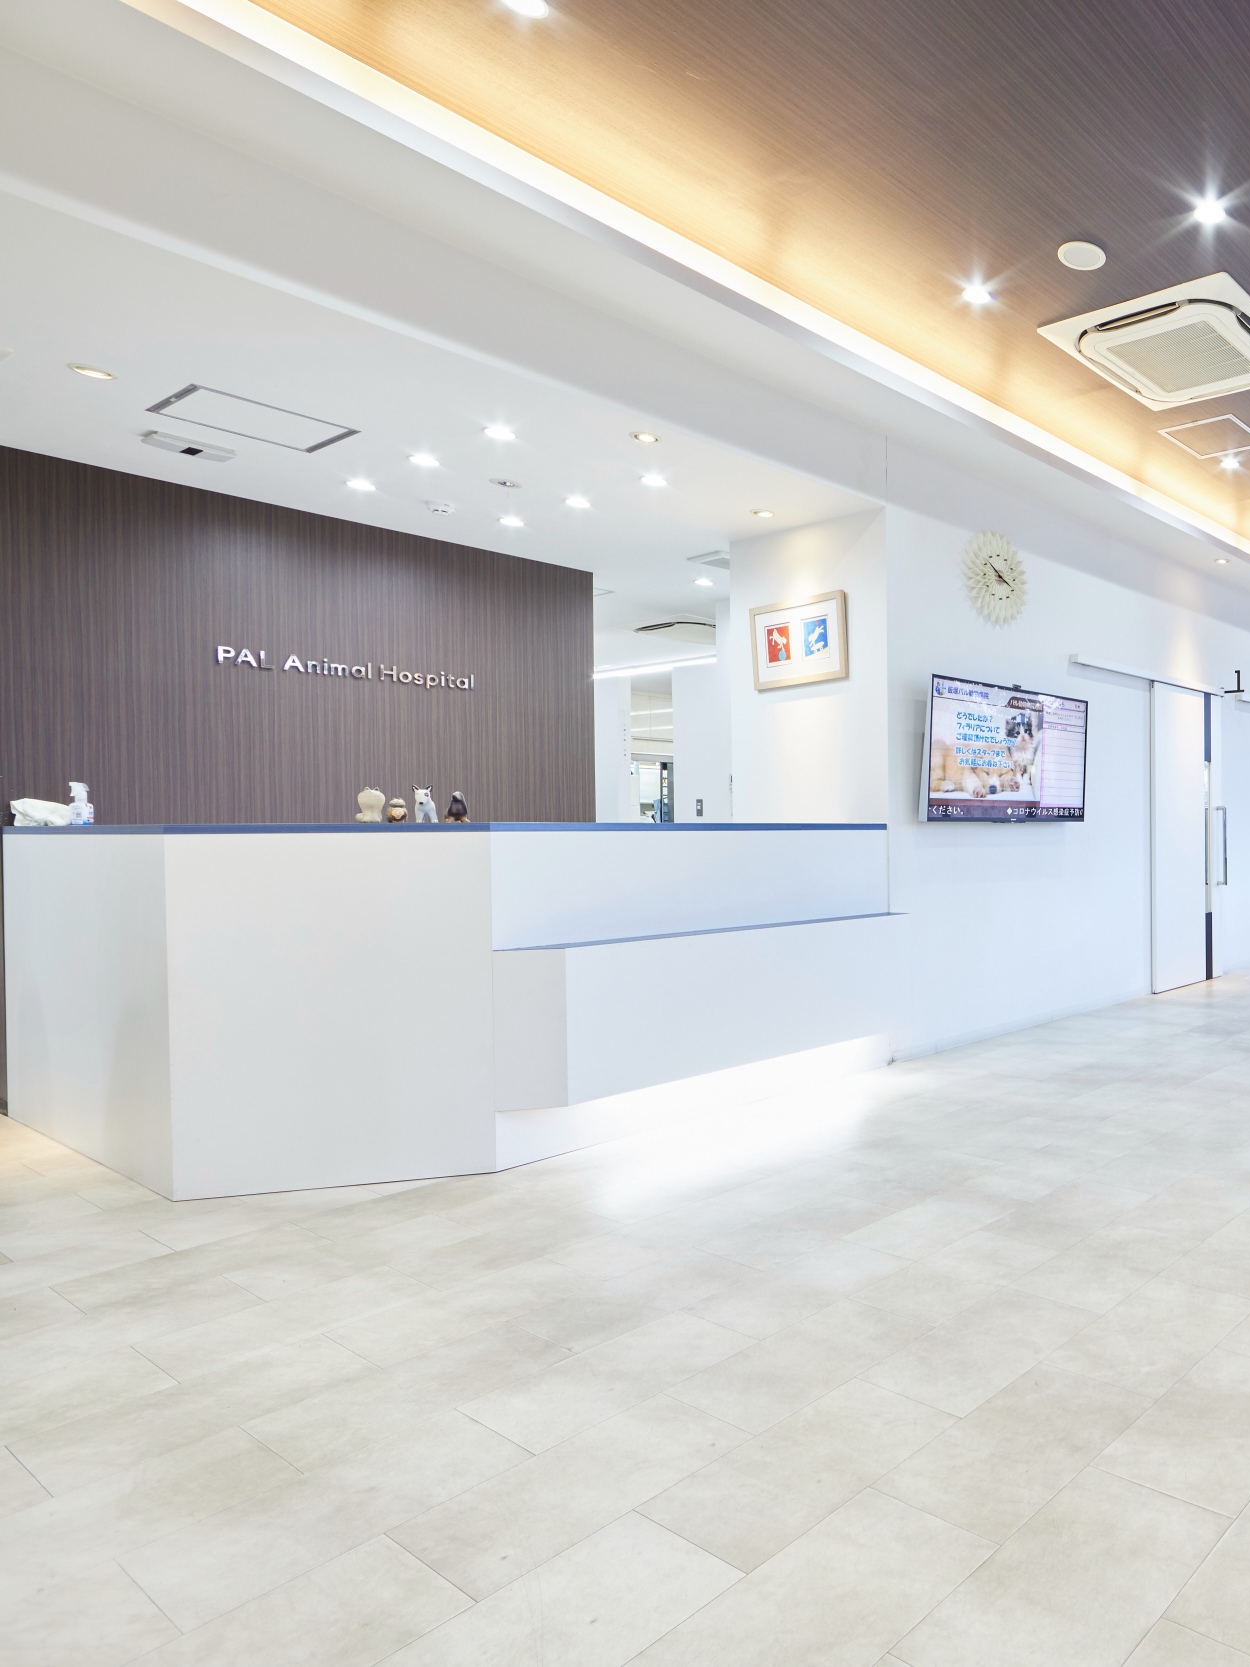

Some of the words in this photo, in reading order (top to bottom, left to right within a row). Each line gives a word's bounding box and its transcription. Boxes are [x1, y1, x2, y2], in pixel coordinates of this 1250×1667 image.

[217, 645, 275, 669] PAL
[283, 653, 372, 679] Animal
[379, 664, 475, 690] Hospital
[928, 805, 964, 816] ください。
